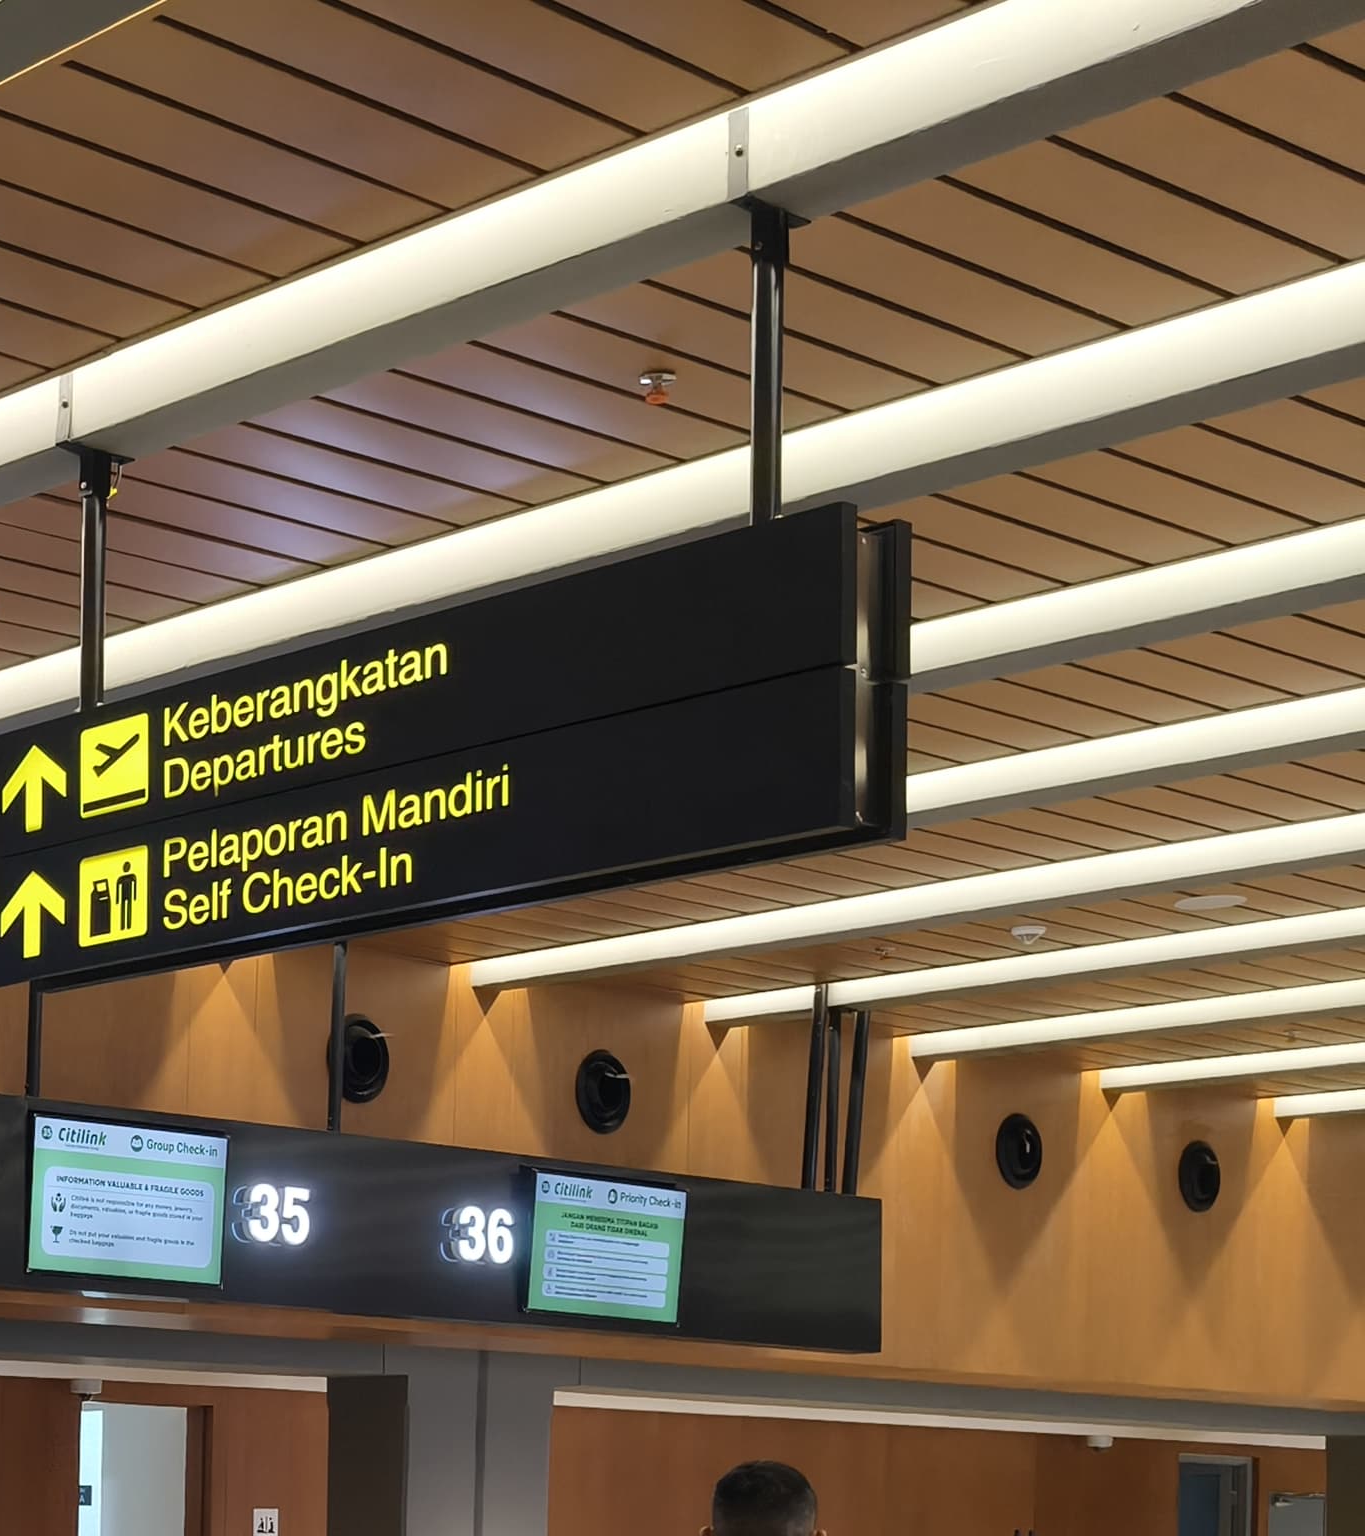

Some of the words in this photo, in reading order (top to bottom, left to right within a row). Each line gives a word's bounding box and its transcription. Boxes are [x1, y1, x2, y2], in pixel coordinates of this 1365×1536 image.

[163, 642, 449, 748] Keberangkatan
[163, 719, 367, 800] Departures
[162, 802, 349, 880] Pelaporan
[361, 764, 511, 835] Mandiri
[162, 882, 232, 932] Self
[241, 846, 413, 916] Check-In
[58, 1127, 107, 1146] Citilink
[146, 1139, 174, 1154] Group
[176, 1142, 218, 1157] Check-in
[56, 1175, 105, 1187] INFORMATION
[107, 1180, 143, 1191] VALUABLE
[150, 1184, 178, 1195] FRAGILE
[248, 1183, 311, 1245] 35
[554, 1182, 594, 1199] Citilink
[620, 1192, 648, 1207] Priority
[458, 1205, 514, 1264] 36
